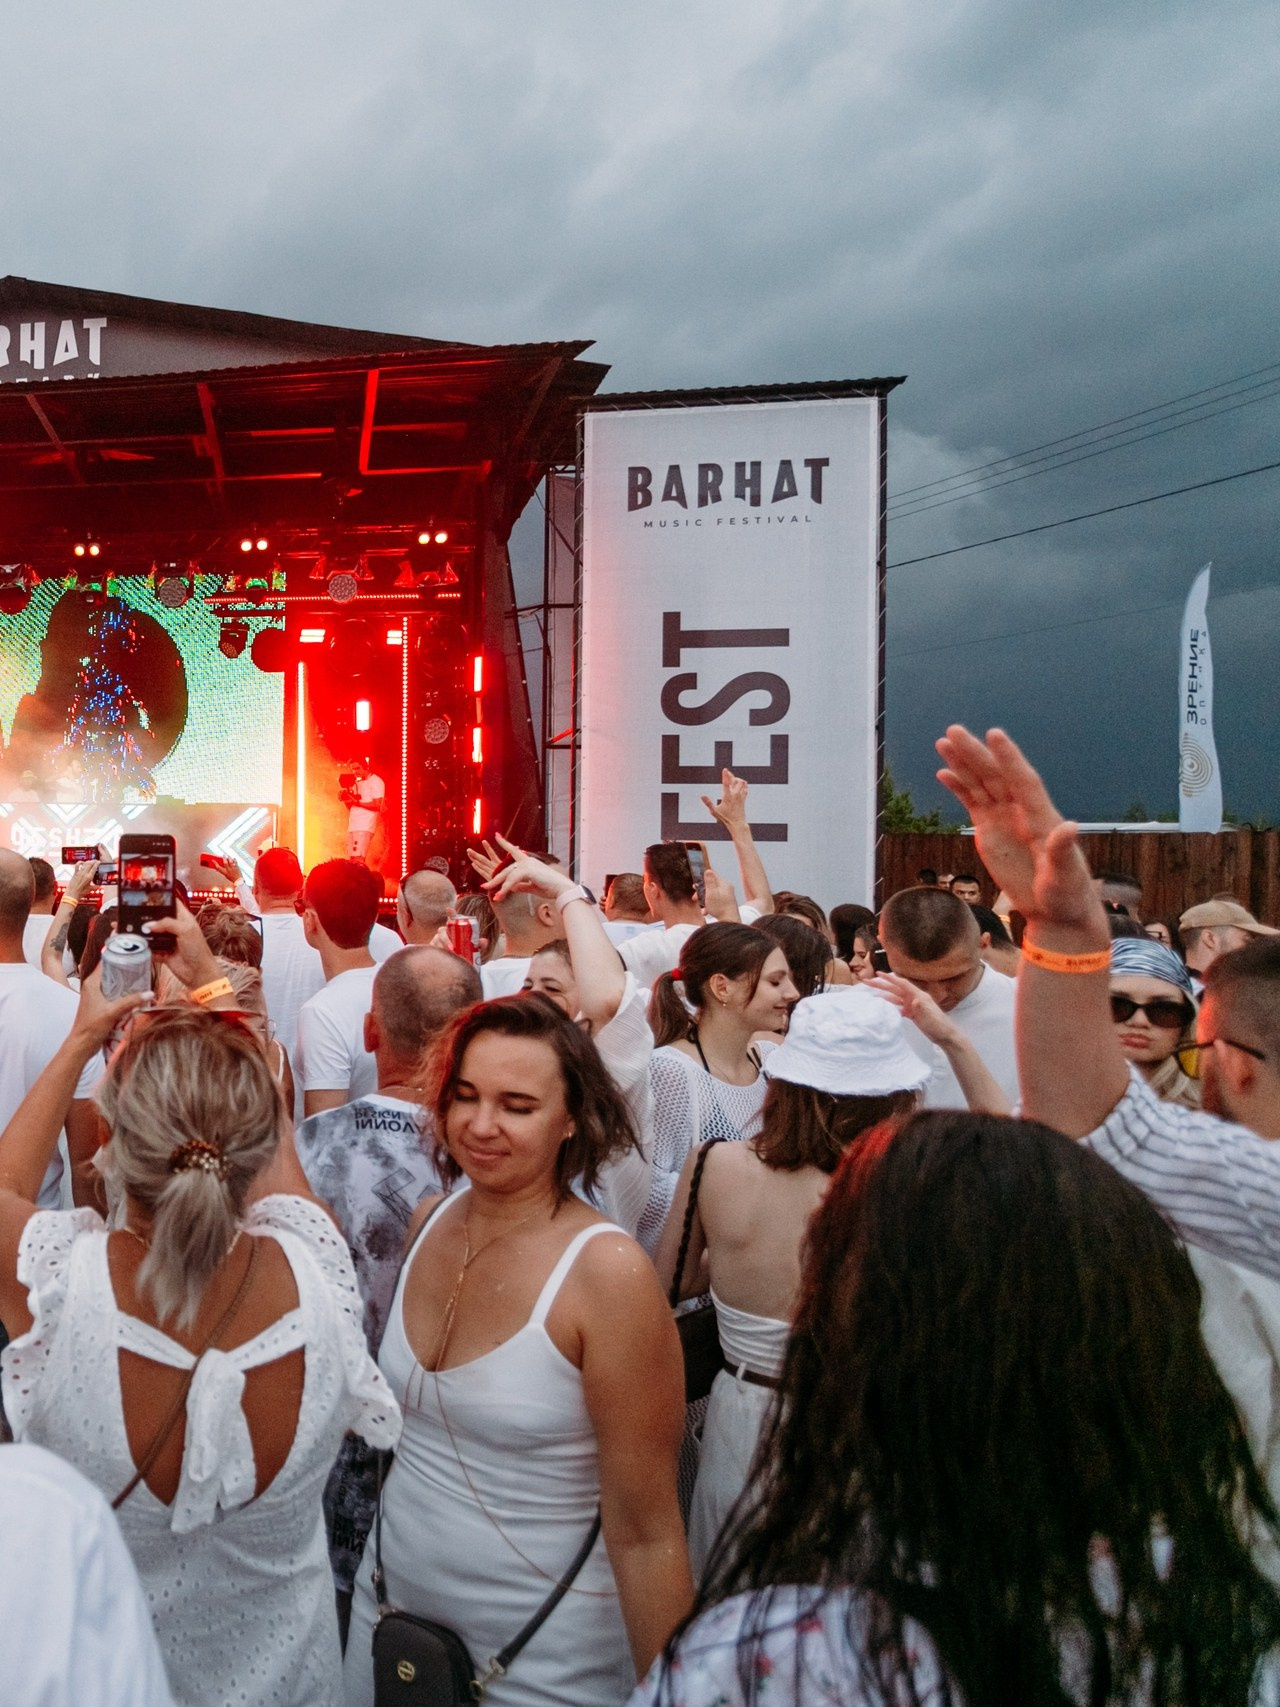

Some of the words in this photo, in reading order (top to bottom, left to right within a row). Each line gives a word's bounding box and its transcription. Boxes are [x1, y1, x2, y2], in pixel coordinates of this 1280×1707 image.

[628, 457, 830, 512] BARHAT
[643, 518, 702, 529] MUSIC
[716, 515, 812, 526] FESTIVAL
[1187, 628, 1199, 725] ЗРЕНИЕ
[660, 611, 791, 842] FEST
